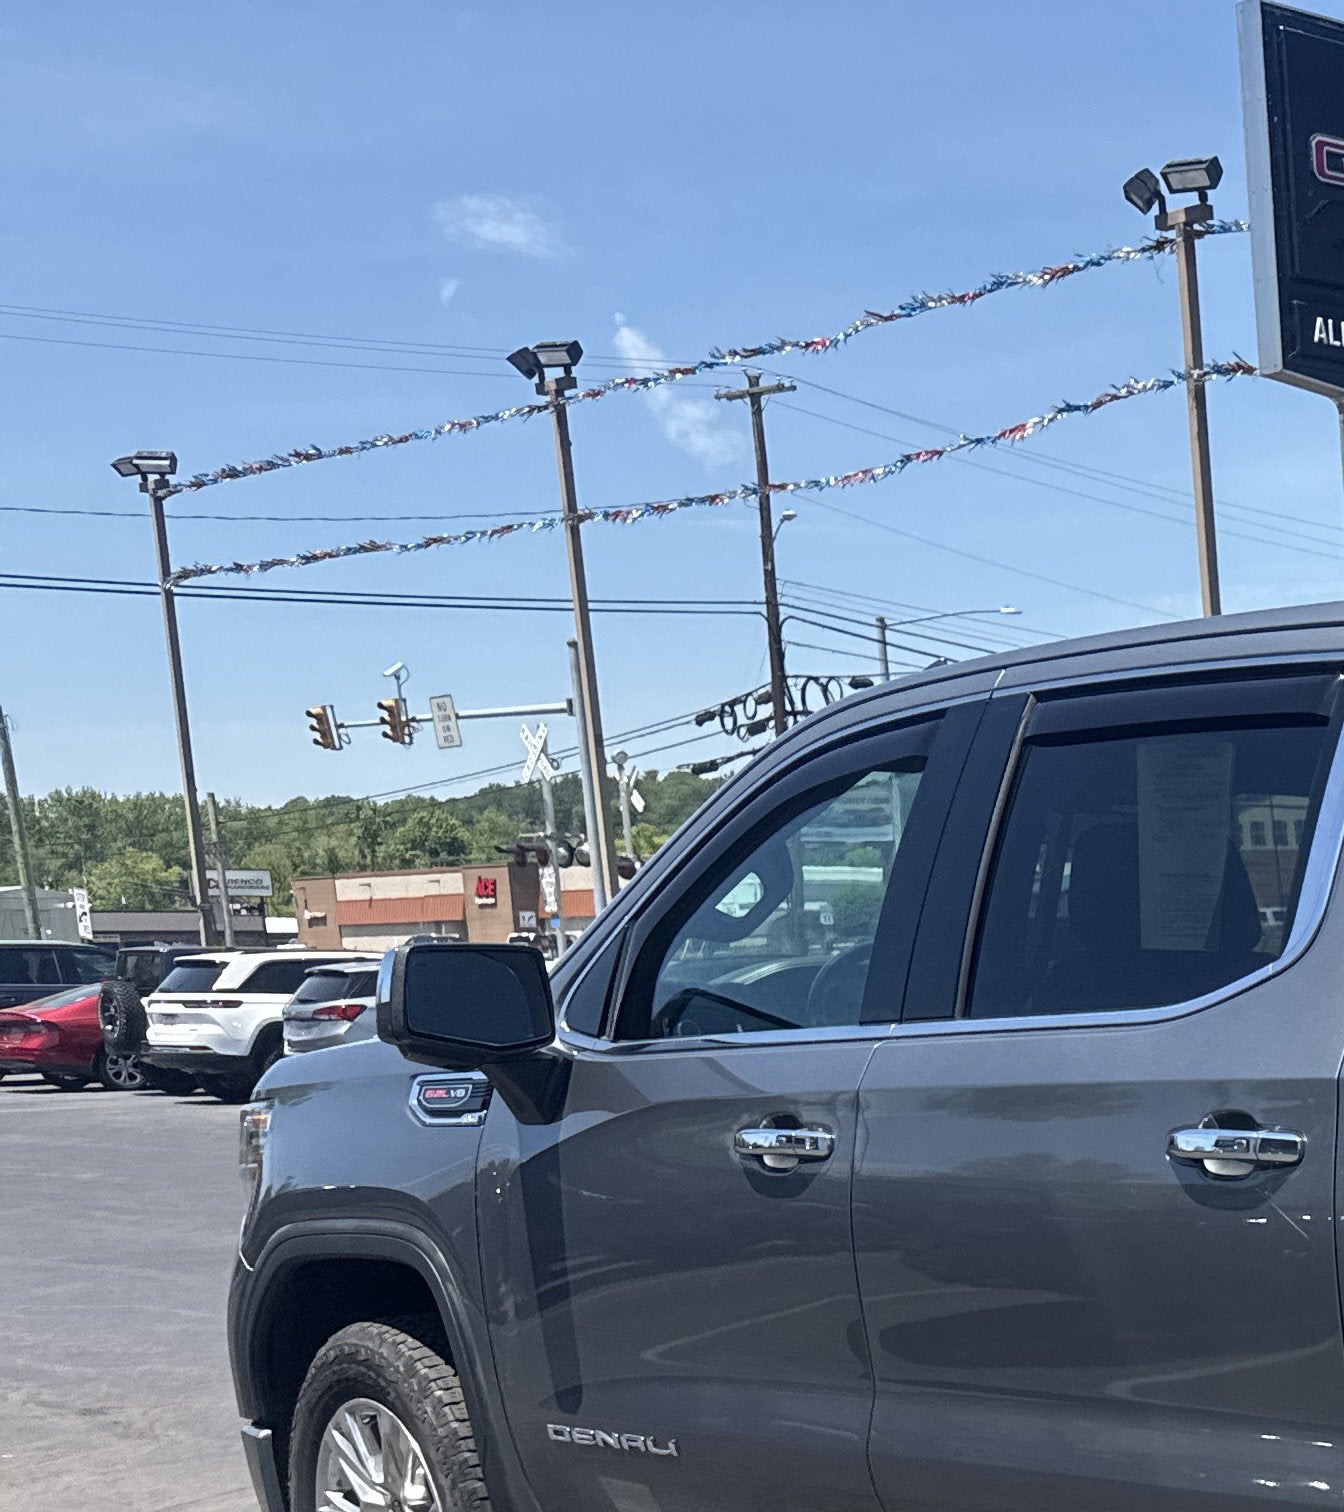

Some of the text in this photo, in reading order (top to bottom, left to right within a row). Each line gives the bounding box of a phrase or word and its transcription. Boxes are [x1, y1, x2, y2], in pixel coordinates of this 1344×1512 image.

[436, 701, 447, 713] NO
[475, 876, 496, 897] ACE
[546, 1423, 680, 1457] DENALI
